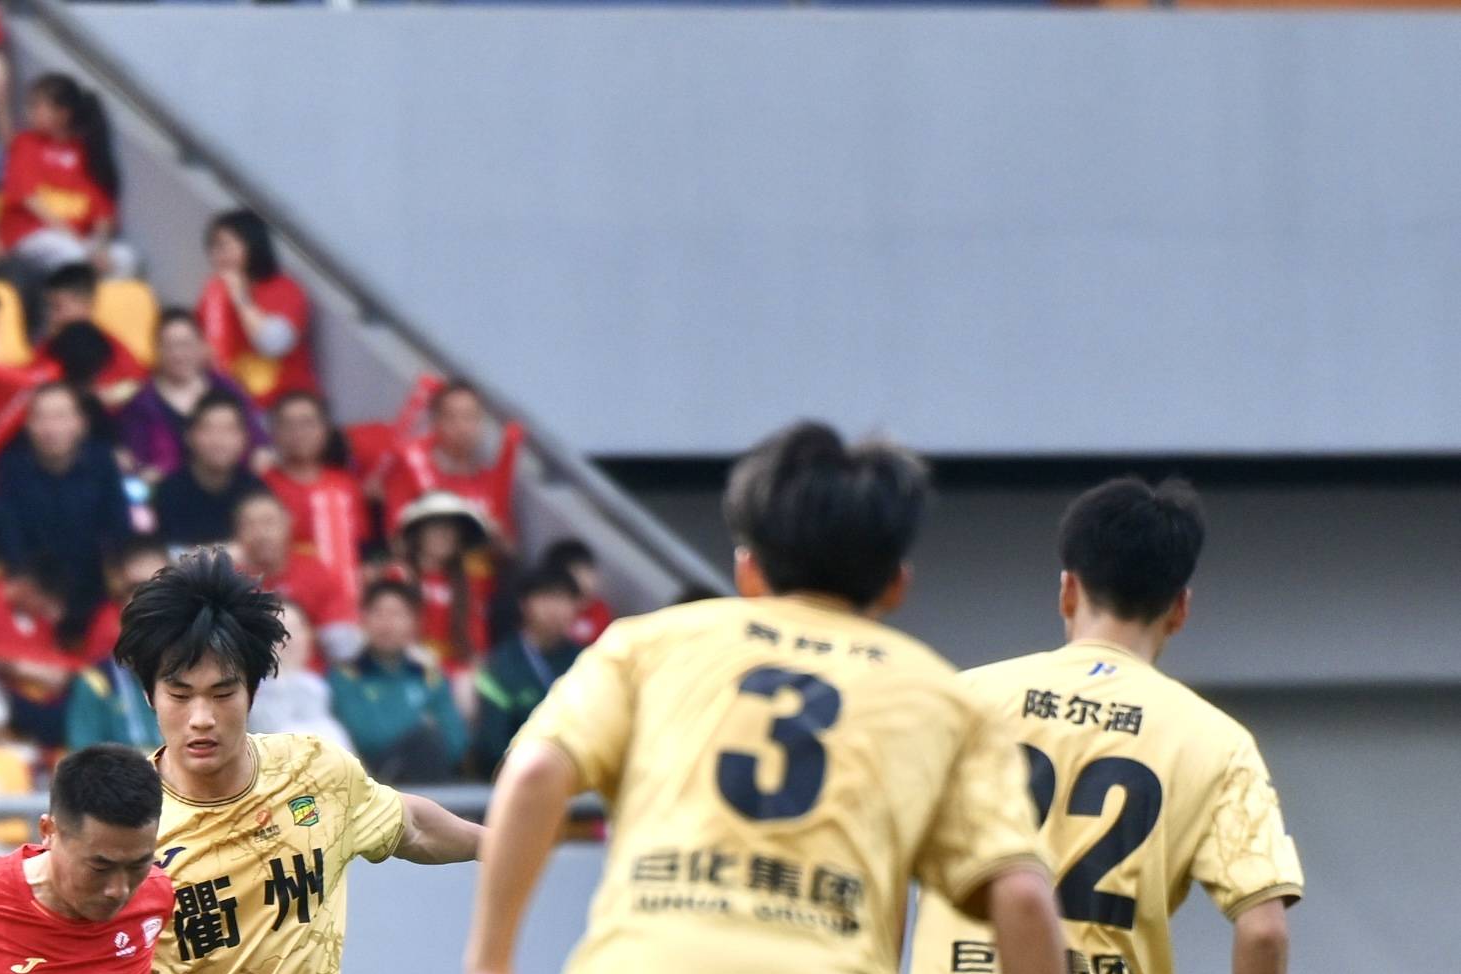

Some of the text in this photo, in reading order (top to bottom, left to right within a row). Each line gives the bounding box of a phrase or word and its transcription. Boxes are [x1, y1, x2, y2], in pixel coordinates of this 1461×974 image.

[717, 664, 843, 822] 3
[1022, 689, 1143, 736] 陈尔涵
[173, 848, 325, 961] 衢州
